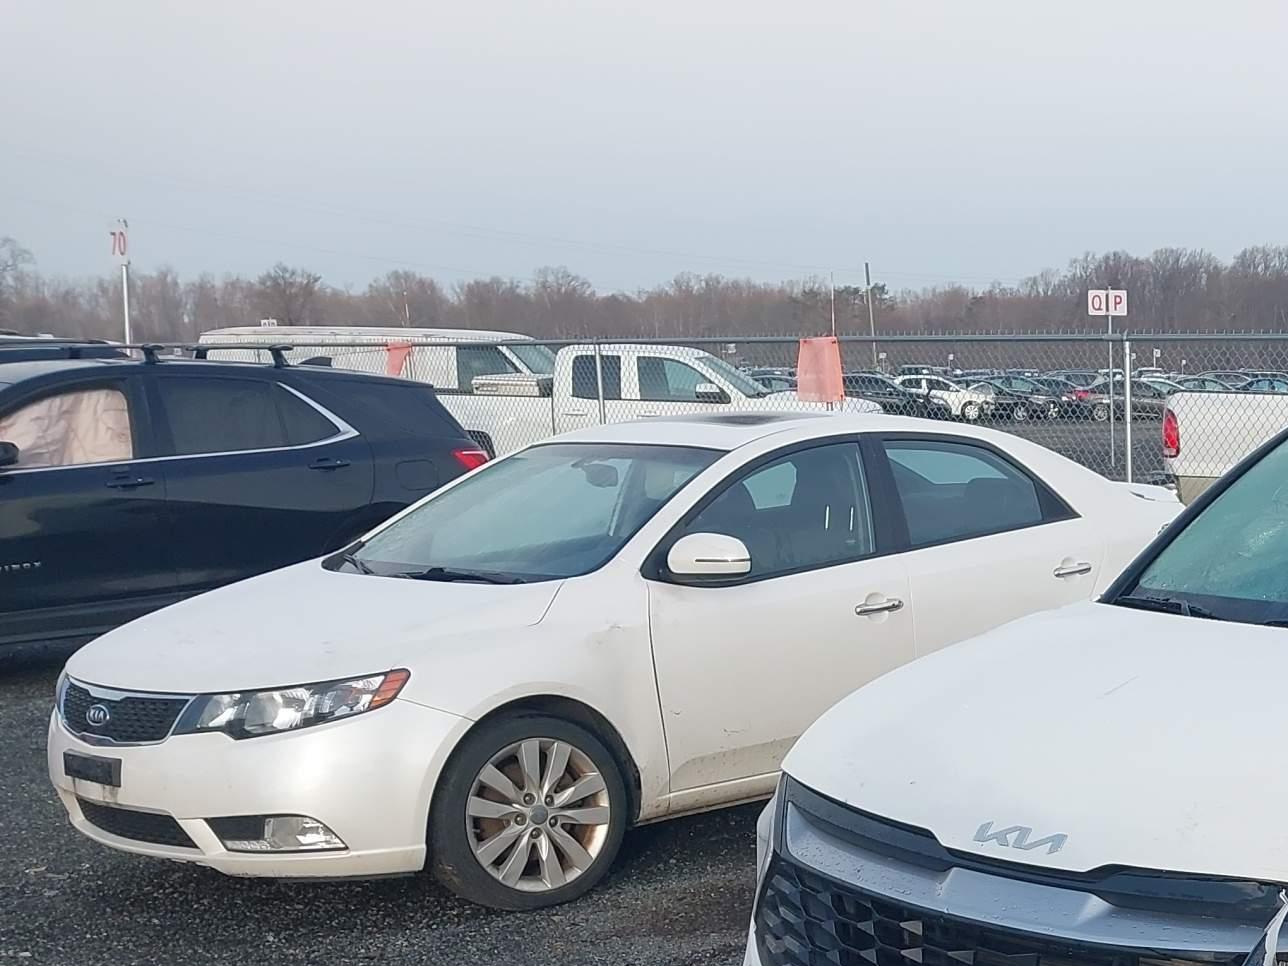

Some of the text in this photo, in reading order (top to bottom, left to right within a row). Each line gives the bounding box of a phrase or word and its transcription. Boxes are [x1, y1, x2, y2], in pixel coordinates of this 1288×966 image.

[110, 231, 127, 256] 70
[1091, 294, 1122, 311] Q P
[90, 709, 105, 721] KIA
